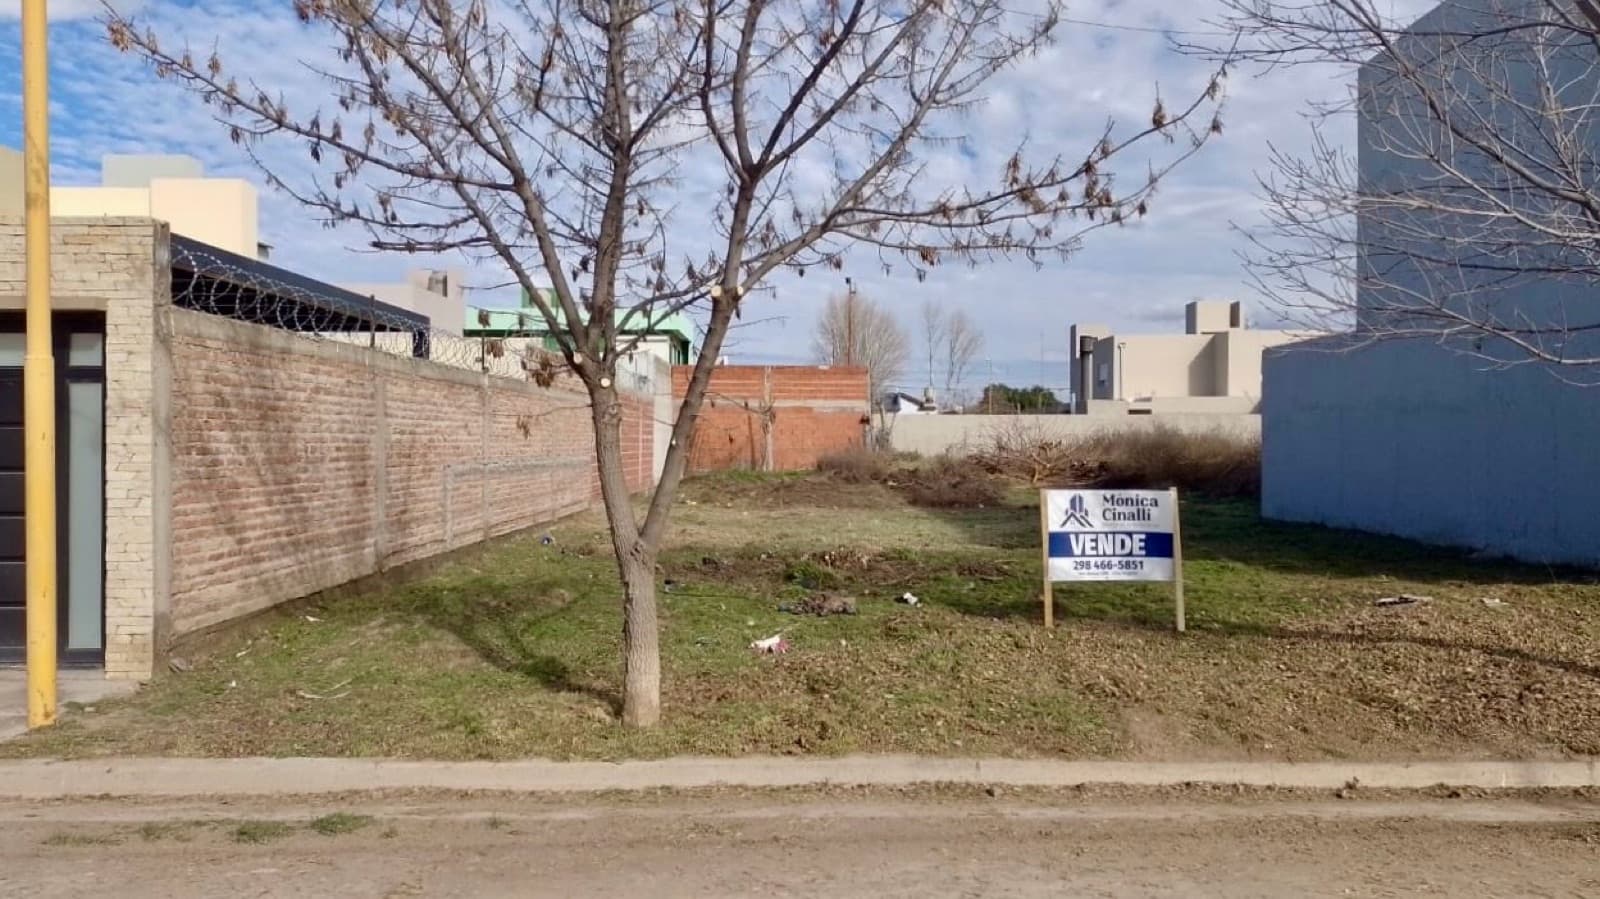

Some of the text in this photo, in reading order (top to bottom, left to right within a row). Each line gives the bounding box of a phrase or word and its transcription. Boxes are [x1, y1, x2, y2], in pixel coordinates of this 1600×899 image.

[1102, 493, 1159, 507] Mónica
[1102, 507, 1151, 521] Cinalli
[1069, 533, 1147, 556] VENDE
[1073, 560, 1144, 570] 298 466-5851
